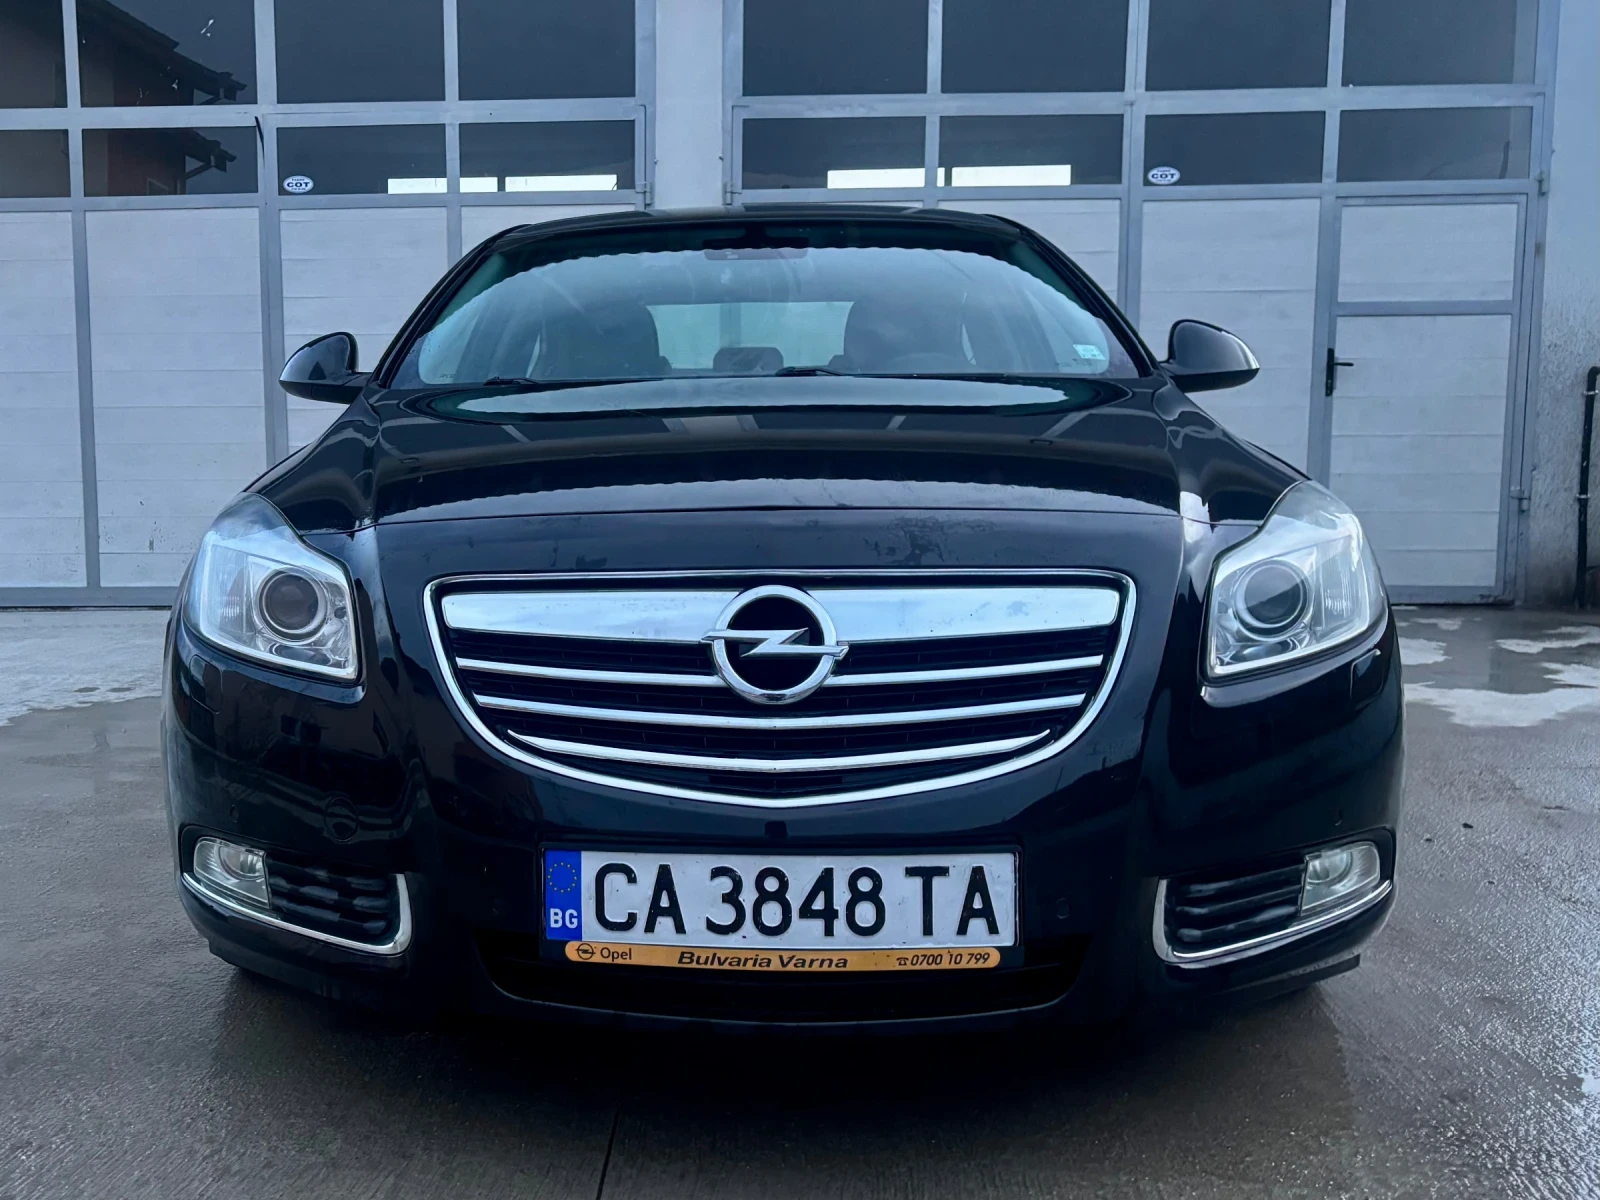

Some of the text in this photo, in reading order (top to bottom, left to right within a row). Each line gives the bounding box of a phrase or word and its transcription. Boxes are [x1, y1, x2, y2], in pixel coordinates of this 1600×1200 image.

[595, 863, 1000, 937] CA 3848 TA
[550, 909, 578, 929] BG
[600, 947, 991, 968] Opel Bulvaria Varna 0700 10 799
